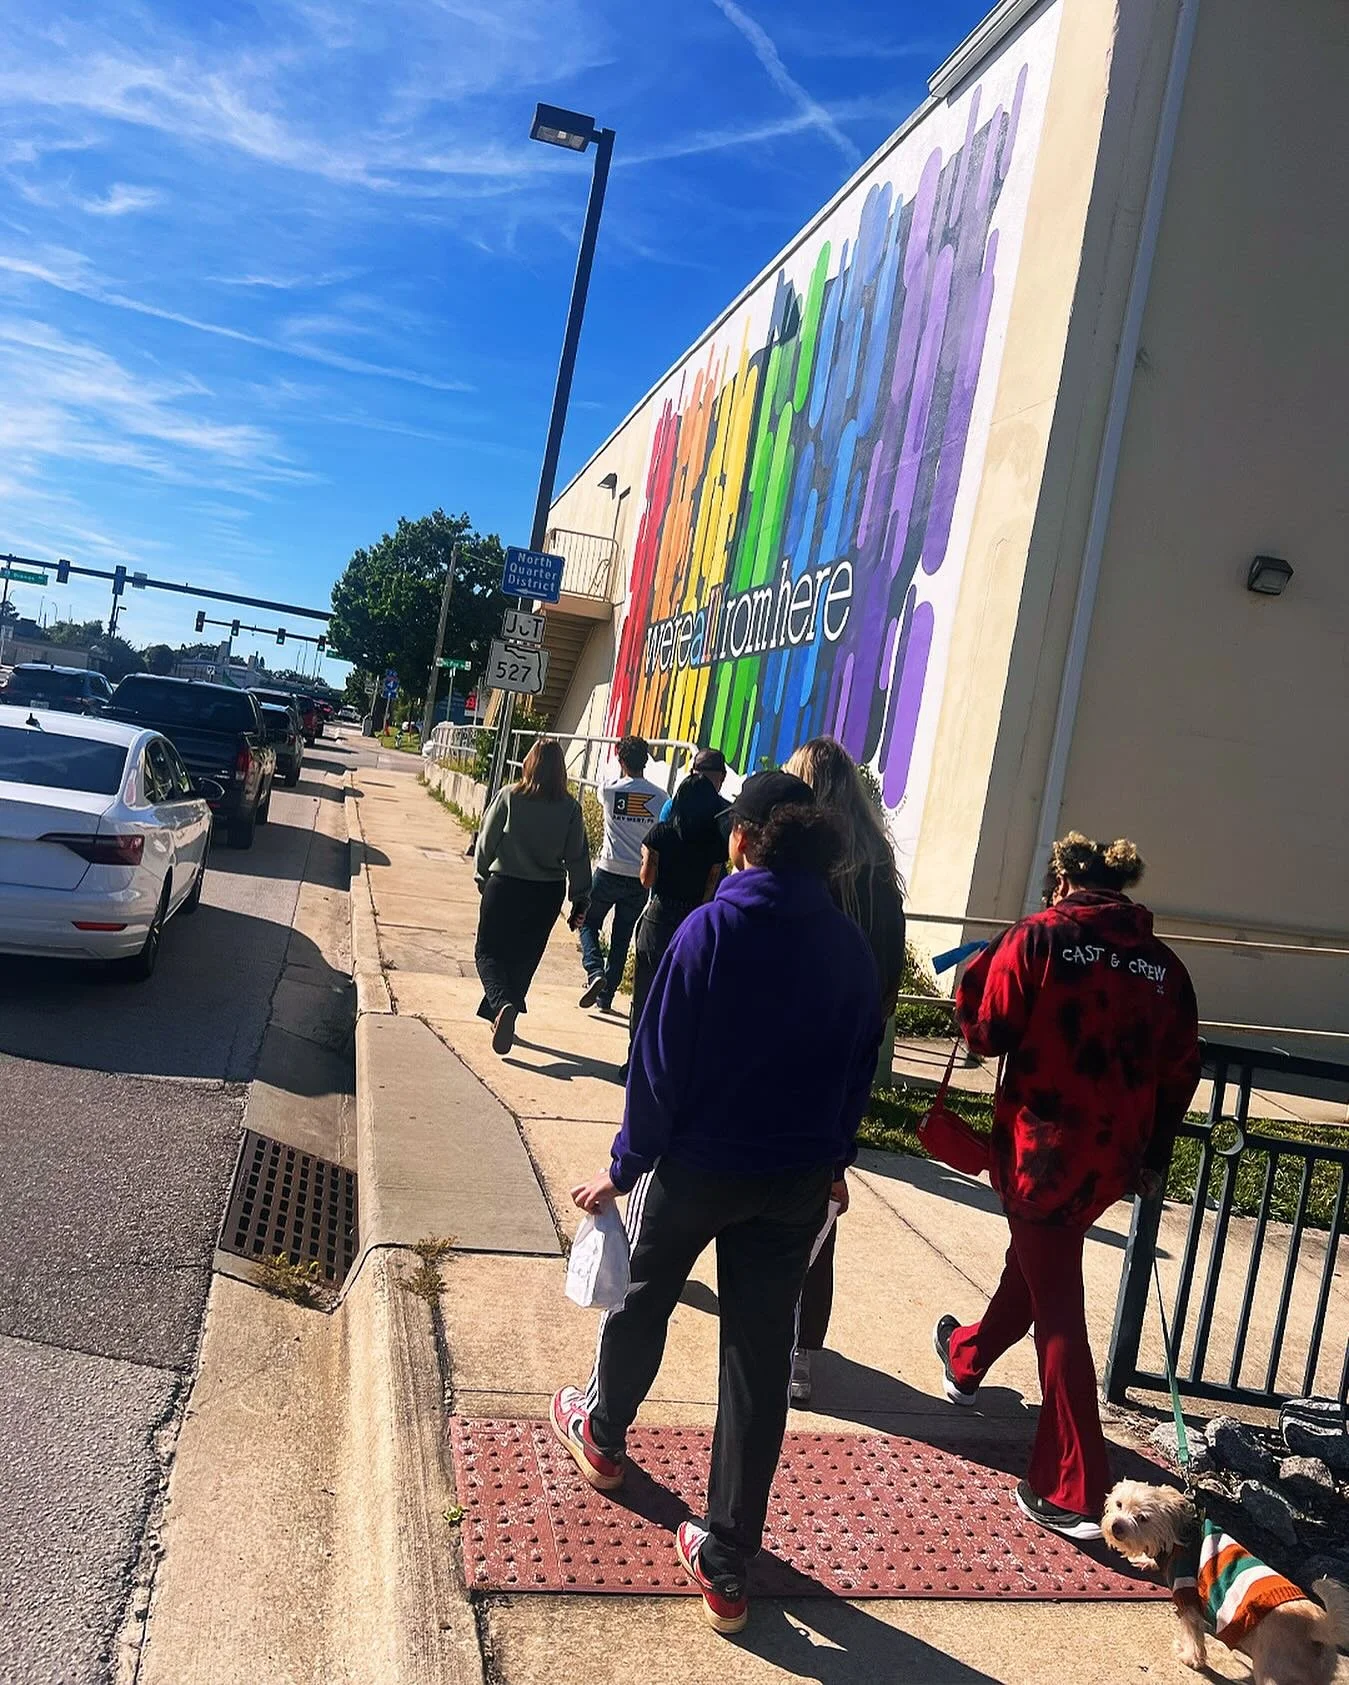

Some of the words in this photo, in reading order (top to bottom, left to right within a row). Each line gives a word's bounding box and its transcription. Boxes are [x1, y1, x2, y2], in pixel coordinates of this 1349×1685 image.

[517, 552, 552, 568] North
[510, 562, 557, 580] Quarter
[508, 574, 555, 592] District
[496, 661, 532, 683] 527
[617, 798, 626, 810] 3
[1062, 945, 1105, 965] CAST
[1110, 953, 1121, 968] &
[1128, 958, 1167, 982] CREW
